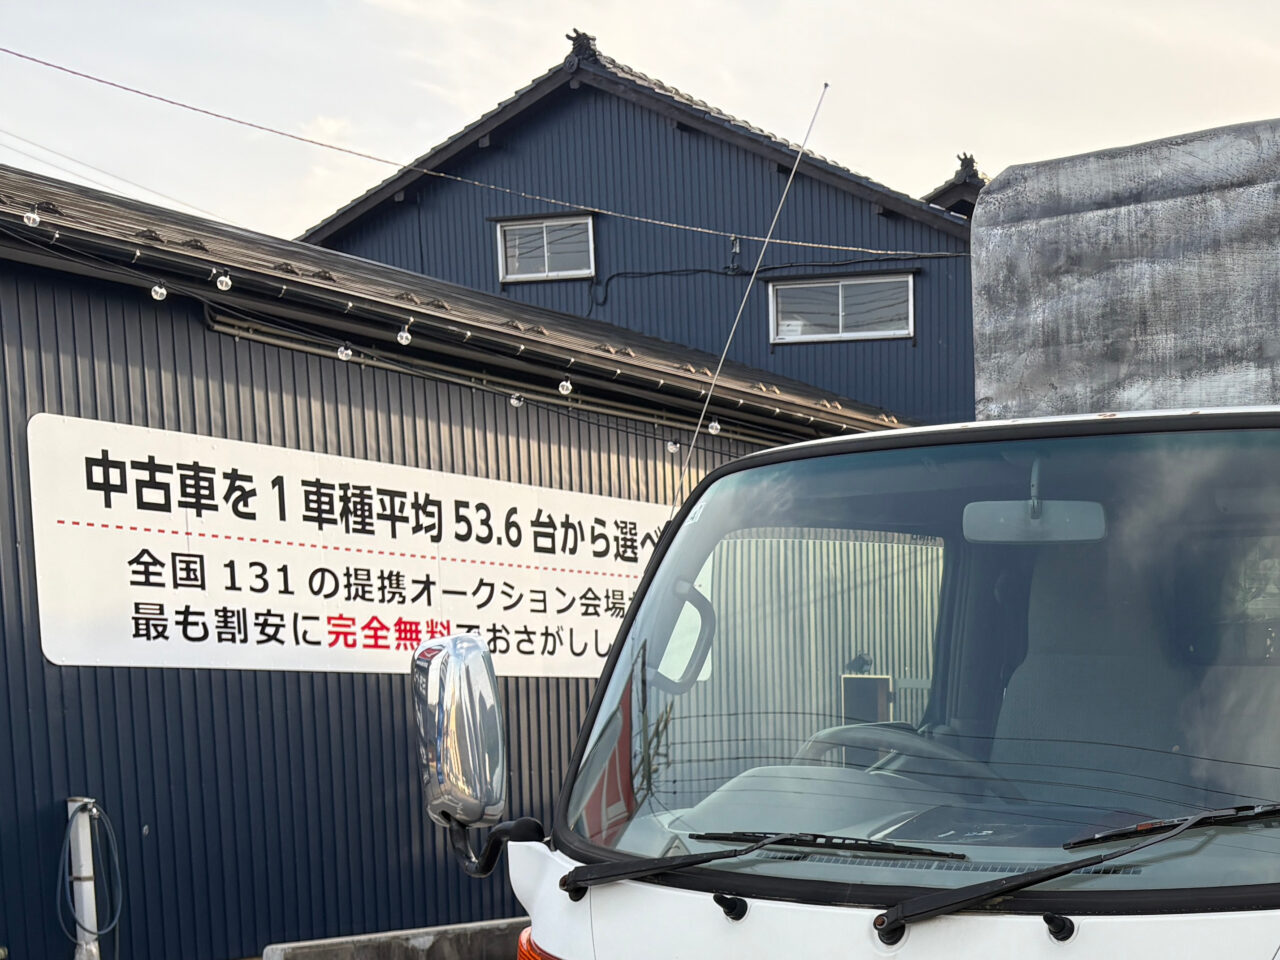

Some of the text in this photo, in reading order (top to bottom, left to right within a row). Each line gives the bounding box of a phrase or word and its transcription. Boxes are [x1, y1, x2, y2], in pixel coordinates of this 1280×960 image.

[128, 549, 636, 618] 全国131の提携オークション会場
